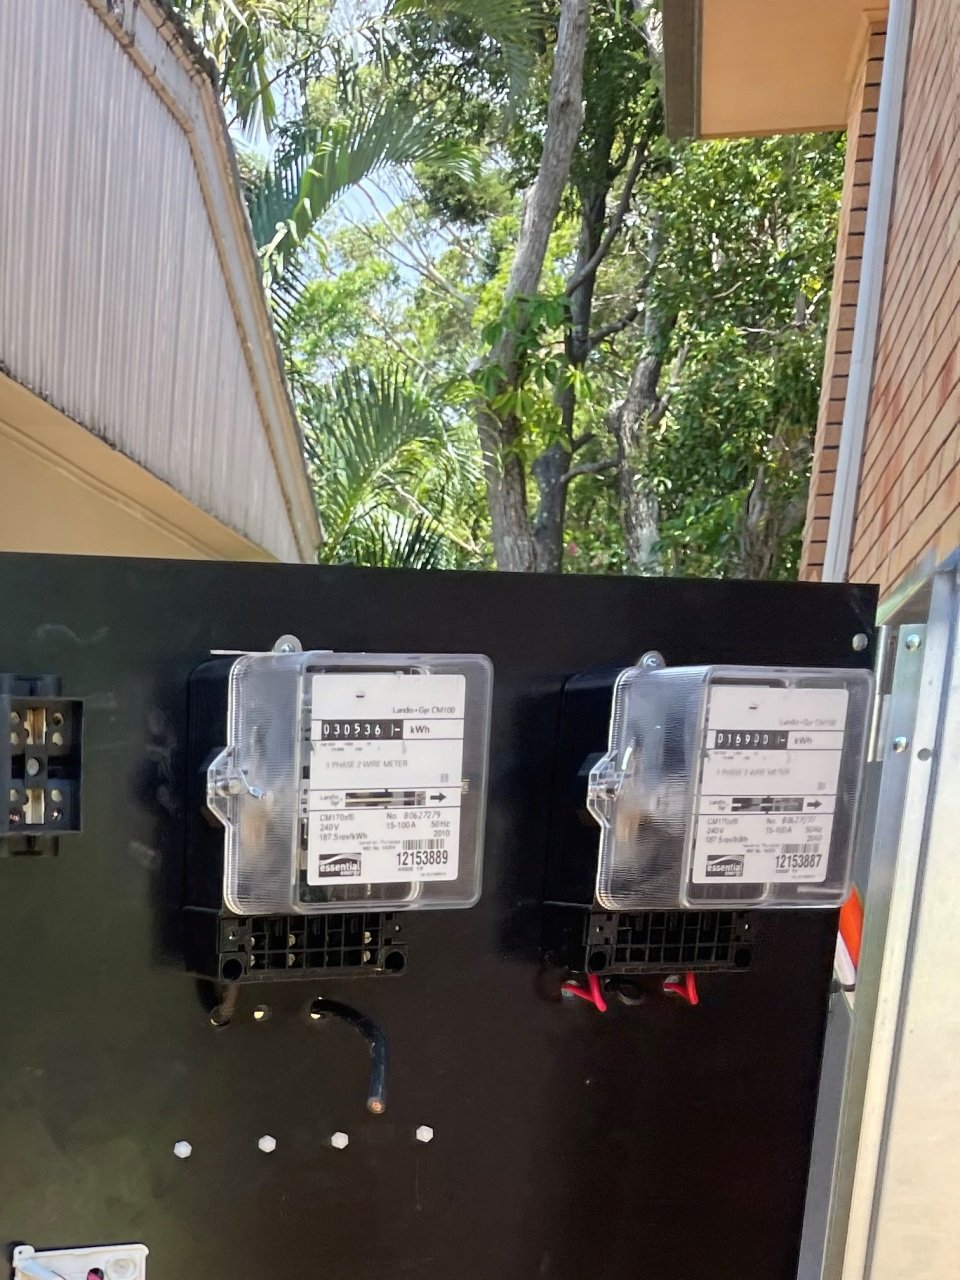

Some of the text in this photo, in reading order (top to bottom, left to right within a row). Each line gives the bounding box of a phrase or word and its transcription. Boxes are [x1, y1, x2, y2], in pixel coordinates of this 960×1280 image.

[410, 725, 430, 734] kWh
[396, 850, 449, 867] 12153889
[775, 854, 823, 869] 12153887
[320, 862, 361, 872] essential
[707, 863, 743, 872] essential
